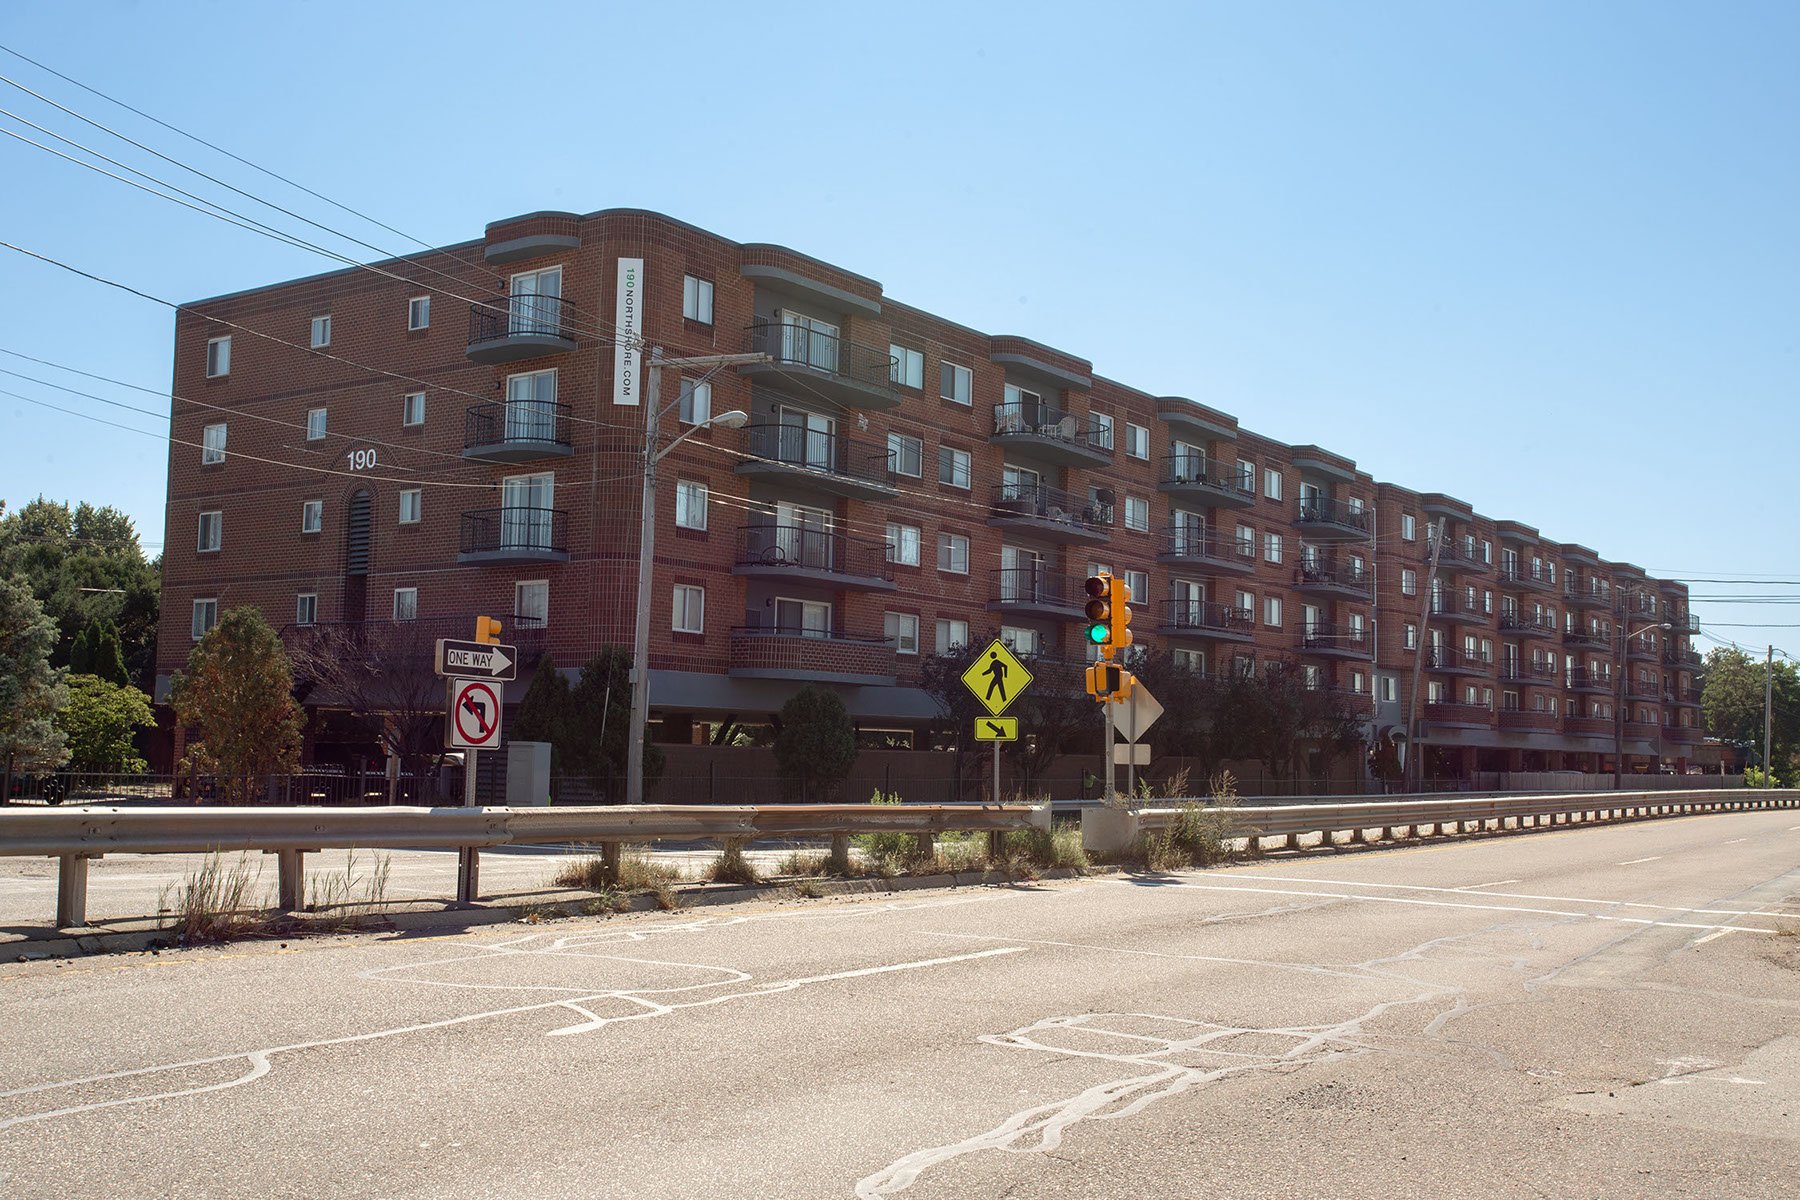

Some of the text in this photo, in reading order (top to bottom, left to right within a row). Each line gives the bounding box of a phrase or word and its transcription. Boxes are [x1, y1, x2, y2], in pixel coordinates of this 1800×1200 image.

[347, 449, 377, 470] 190
[449, 651, 493, 667] ONE WAY
